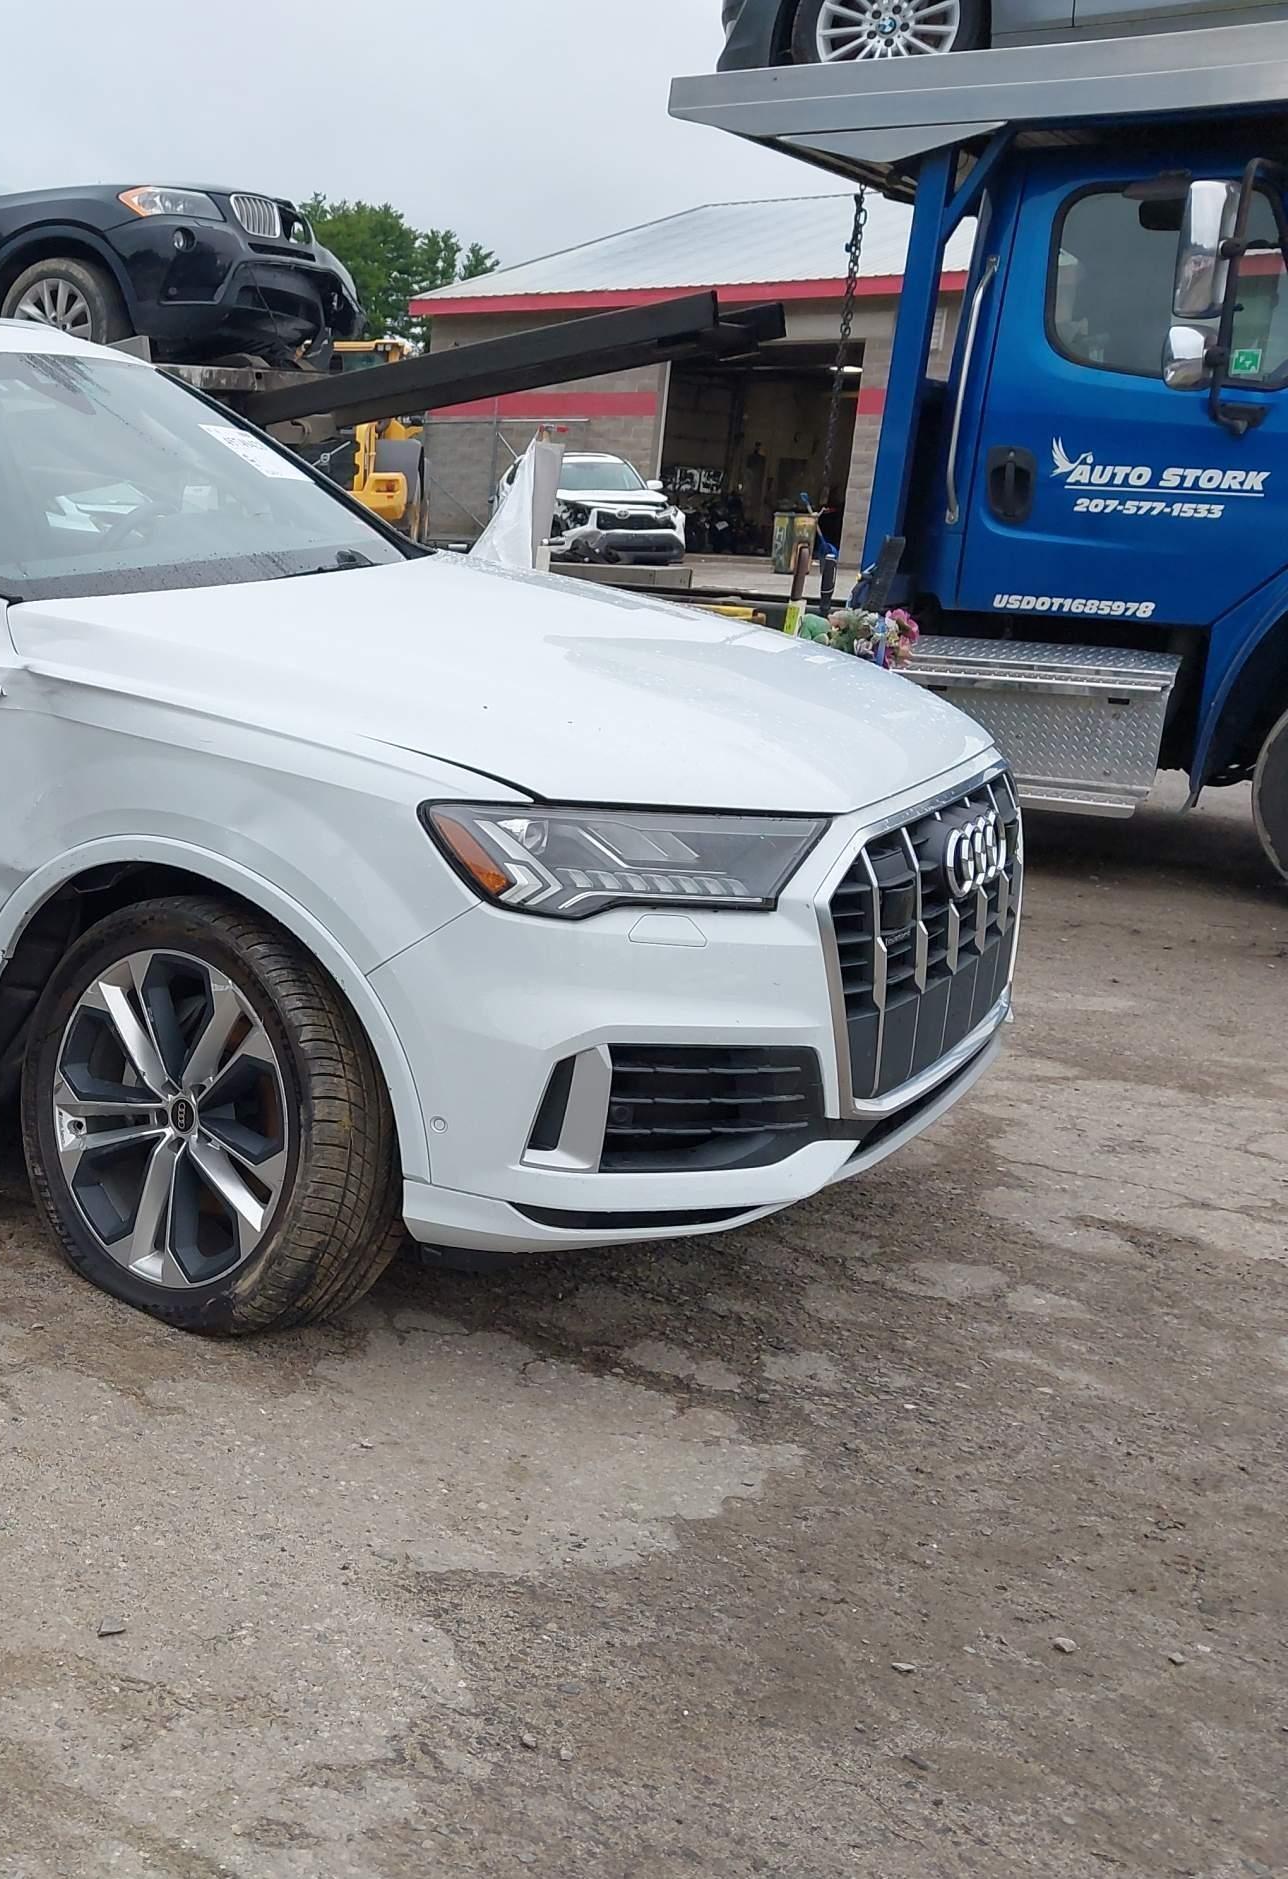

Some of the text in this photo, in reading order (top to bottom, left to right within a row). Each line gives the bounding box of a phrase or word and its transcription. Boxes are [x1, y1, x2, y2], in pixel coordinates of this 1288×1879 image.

[1065, 464, 1272, 491] AUTO STORK
[1073, 498, 1225, 519] 207-577-1533
[992, 594, 1156, 618] USDOT1685978
